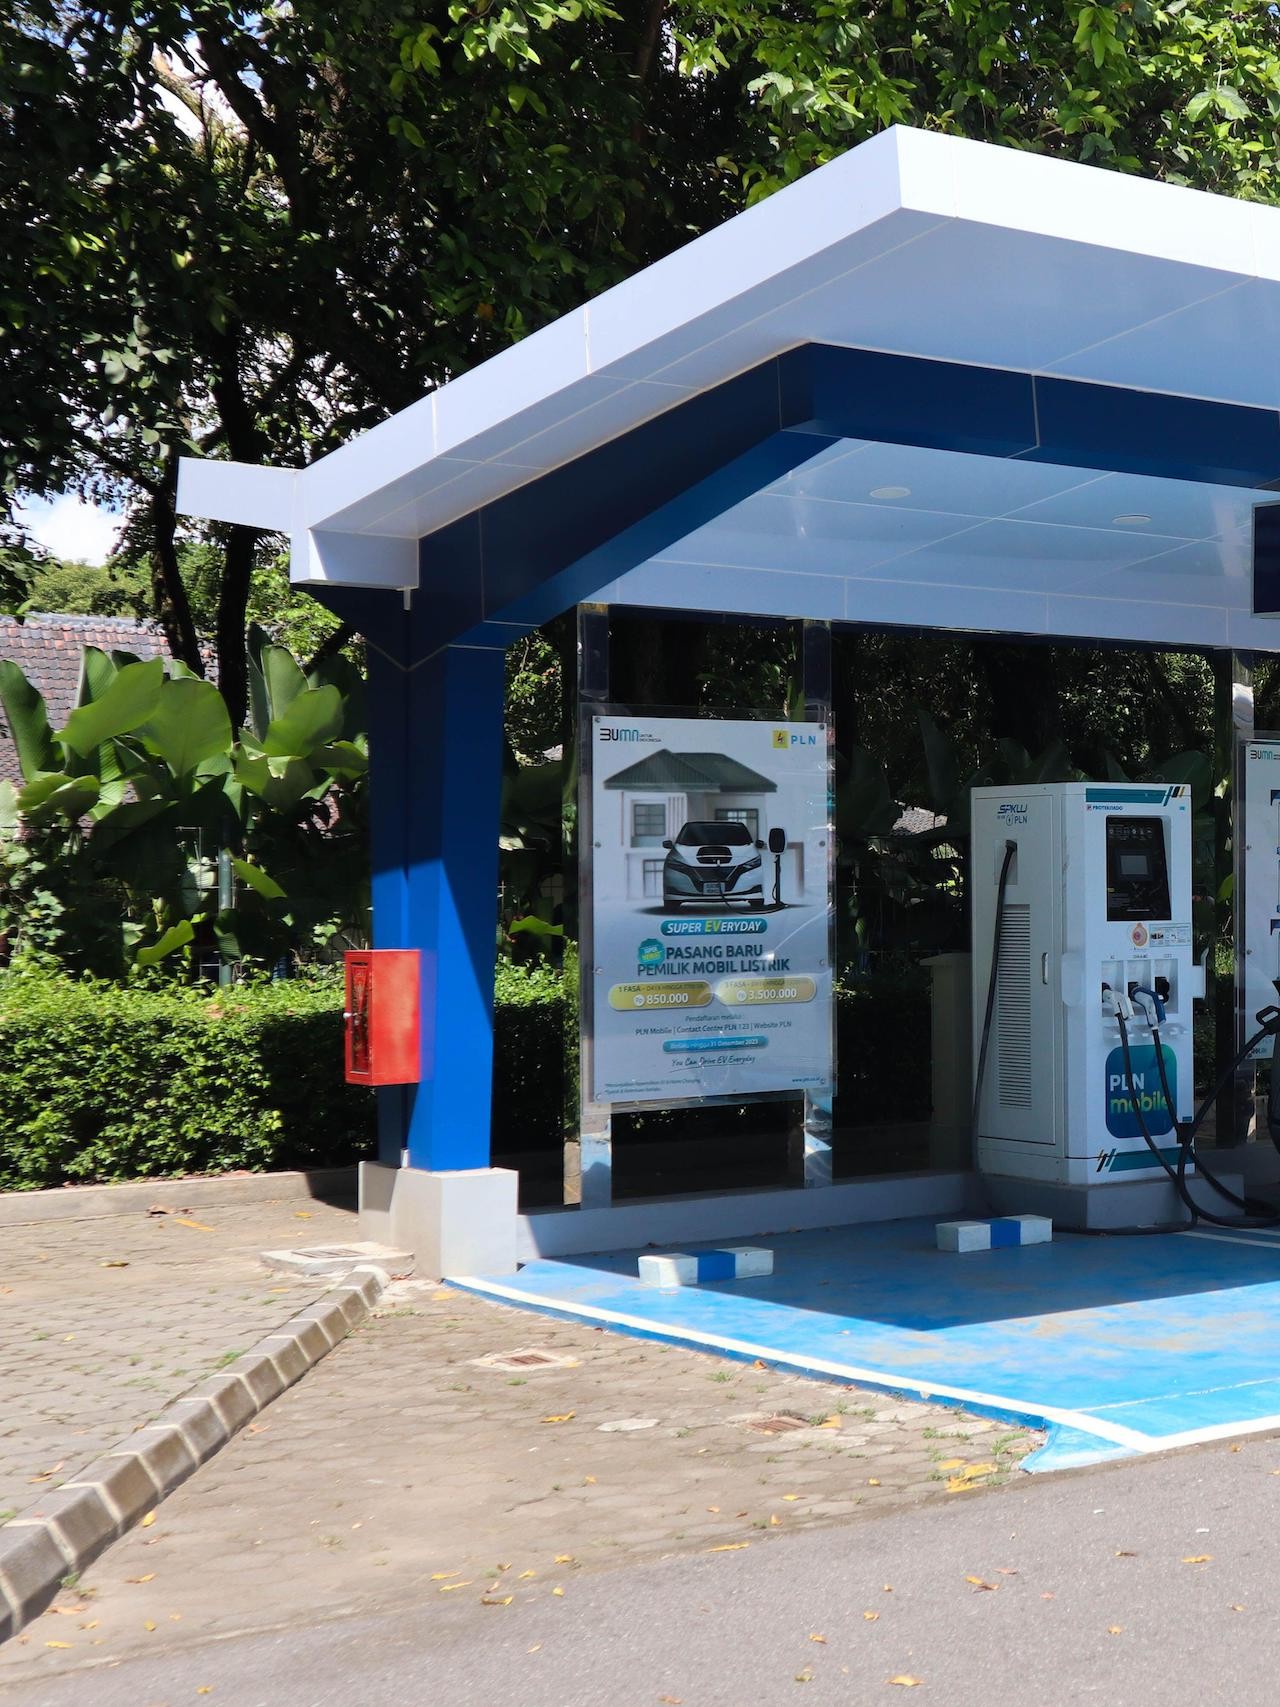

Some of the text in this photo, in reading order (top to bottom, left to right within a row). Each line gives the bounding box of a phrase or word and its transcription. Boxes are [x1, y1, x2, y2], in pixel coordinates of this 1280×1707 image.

[790, 735, 817, 745] PLN
[1014, 815, 1028, 824] PLN
[667, 920, 762, 934] SUPER EVERYDAY
[666, 945, 722, 960] PASANG
[726, 944, 763, 957] BARU
[637, 958, 790, 976] PEMILIK MOBIL LISTRIK
[646, 993, 689, 1005] 850.000
[748, 988, 797, 1000] 3.500.000
[635, 1028, 649, 1036] PLN
[676, 1025, 702, 1034] Contact
[1109, 1072, 1145, 1091] PLN
